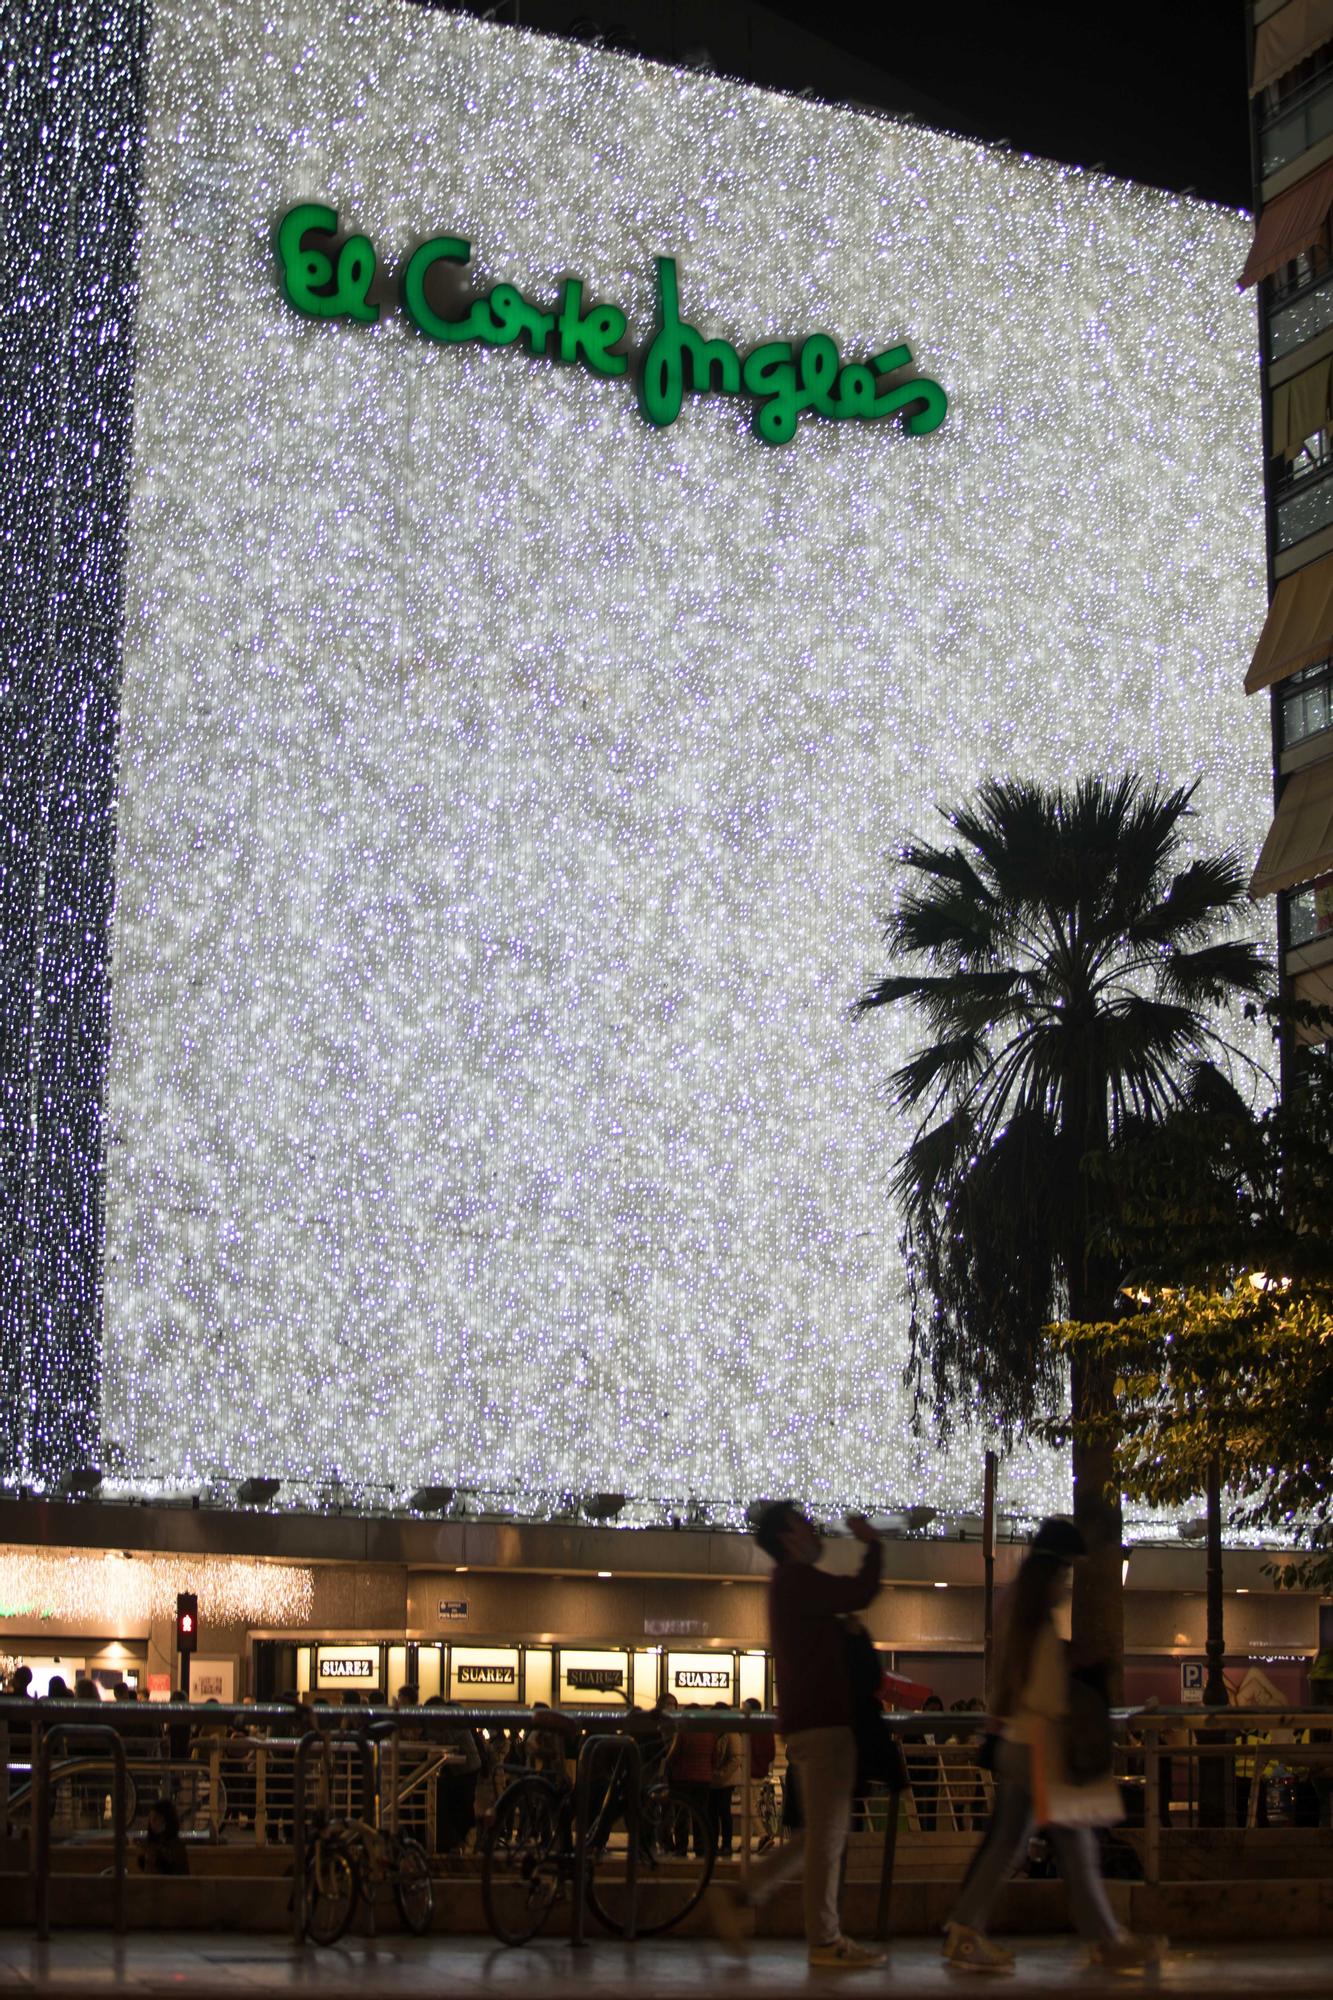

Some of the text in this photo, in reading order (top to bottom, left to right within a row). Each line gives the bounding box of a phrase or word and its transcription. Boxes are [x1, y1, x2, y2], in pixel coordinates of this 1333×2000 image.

[277, 203, 947, 444] El Corte Inglés
[322, 1661, 370, 1676] SUAREZ
[461, 1667, 512, 1683] SUAREZ
[1185, 1665, 1199, 1687] P
[678, 1672, 728, 1688] SUAREZ
